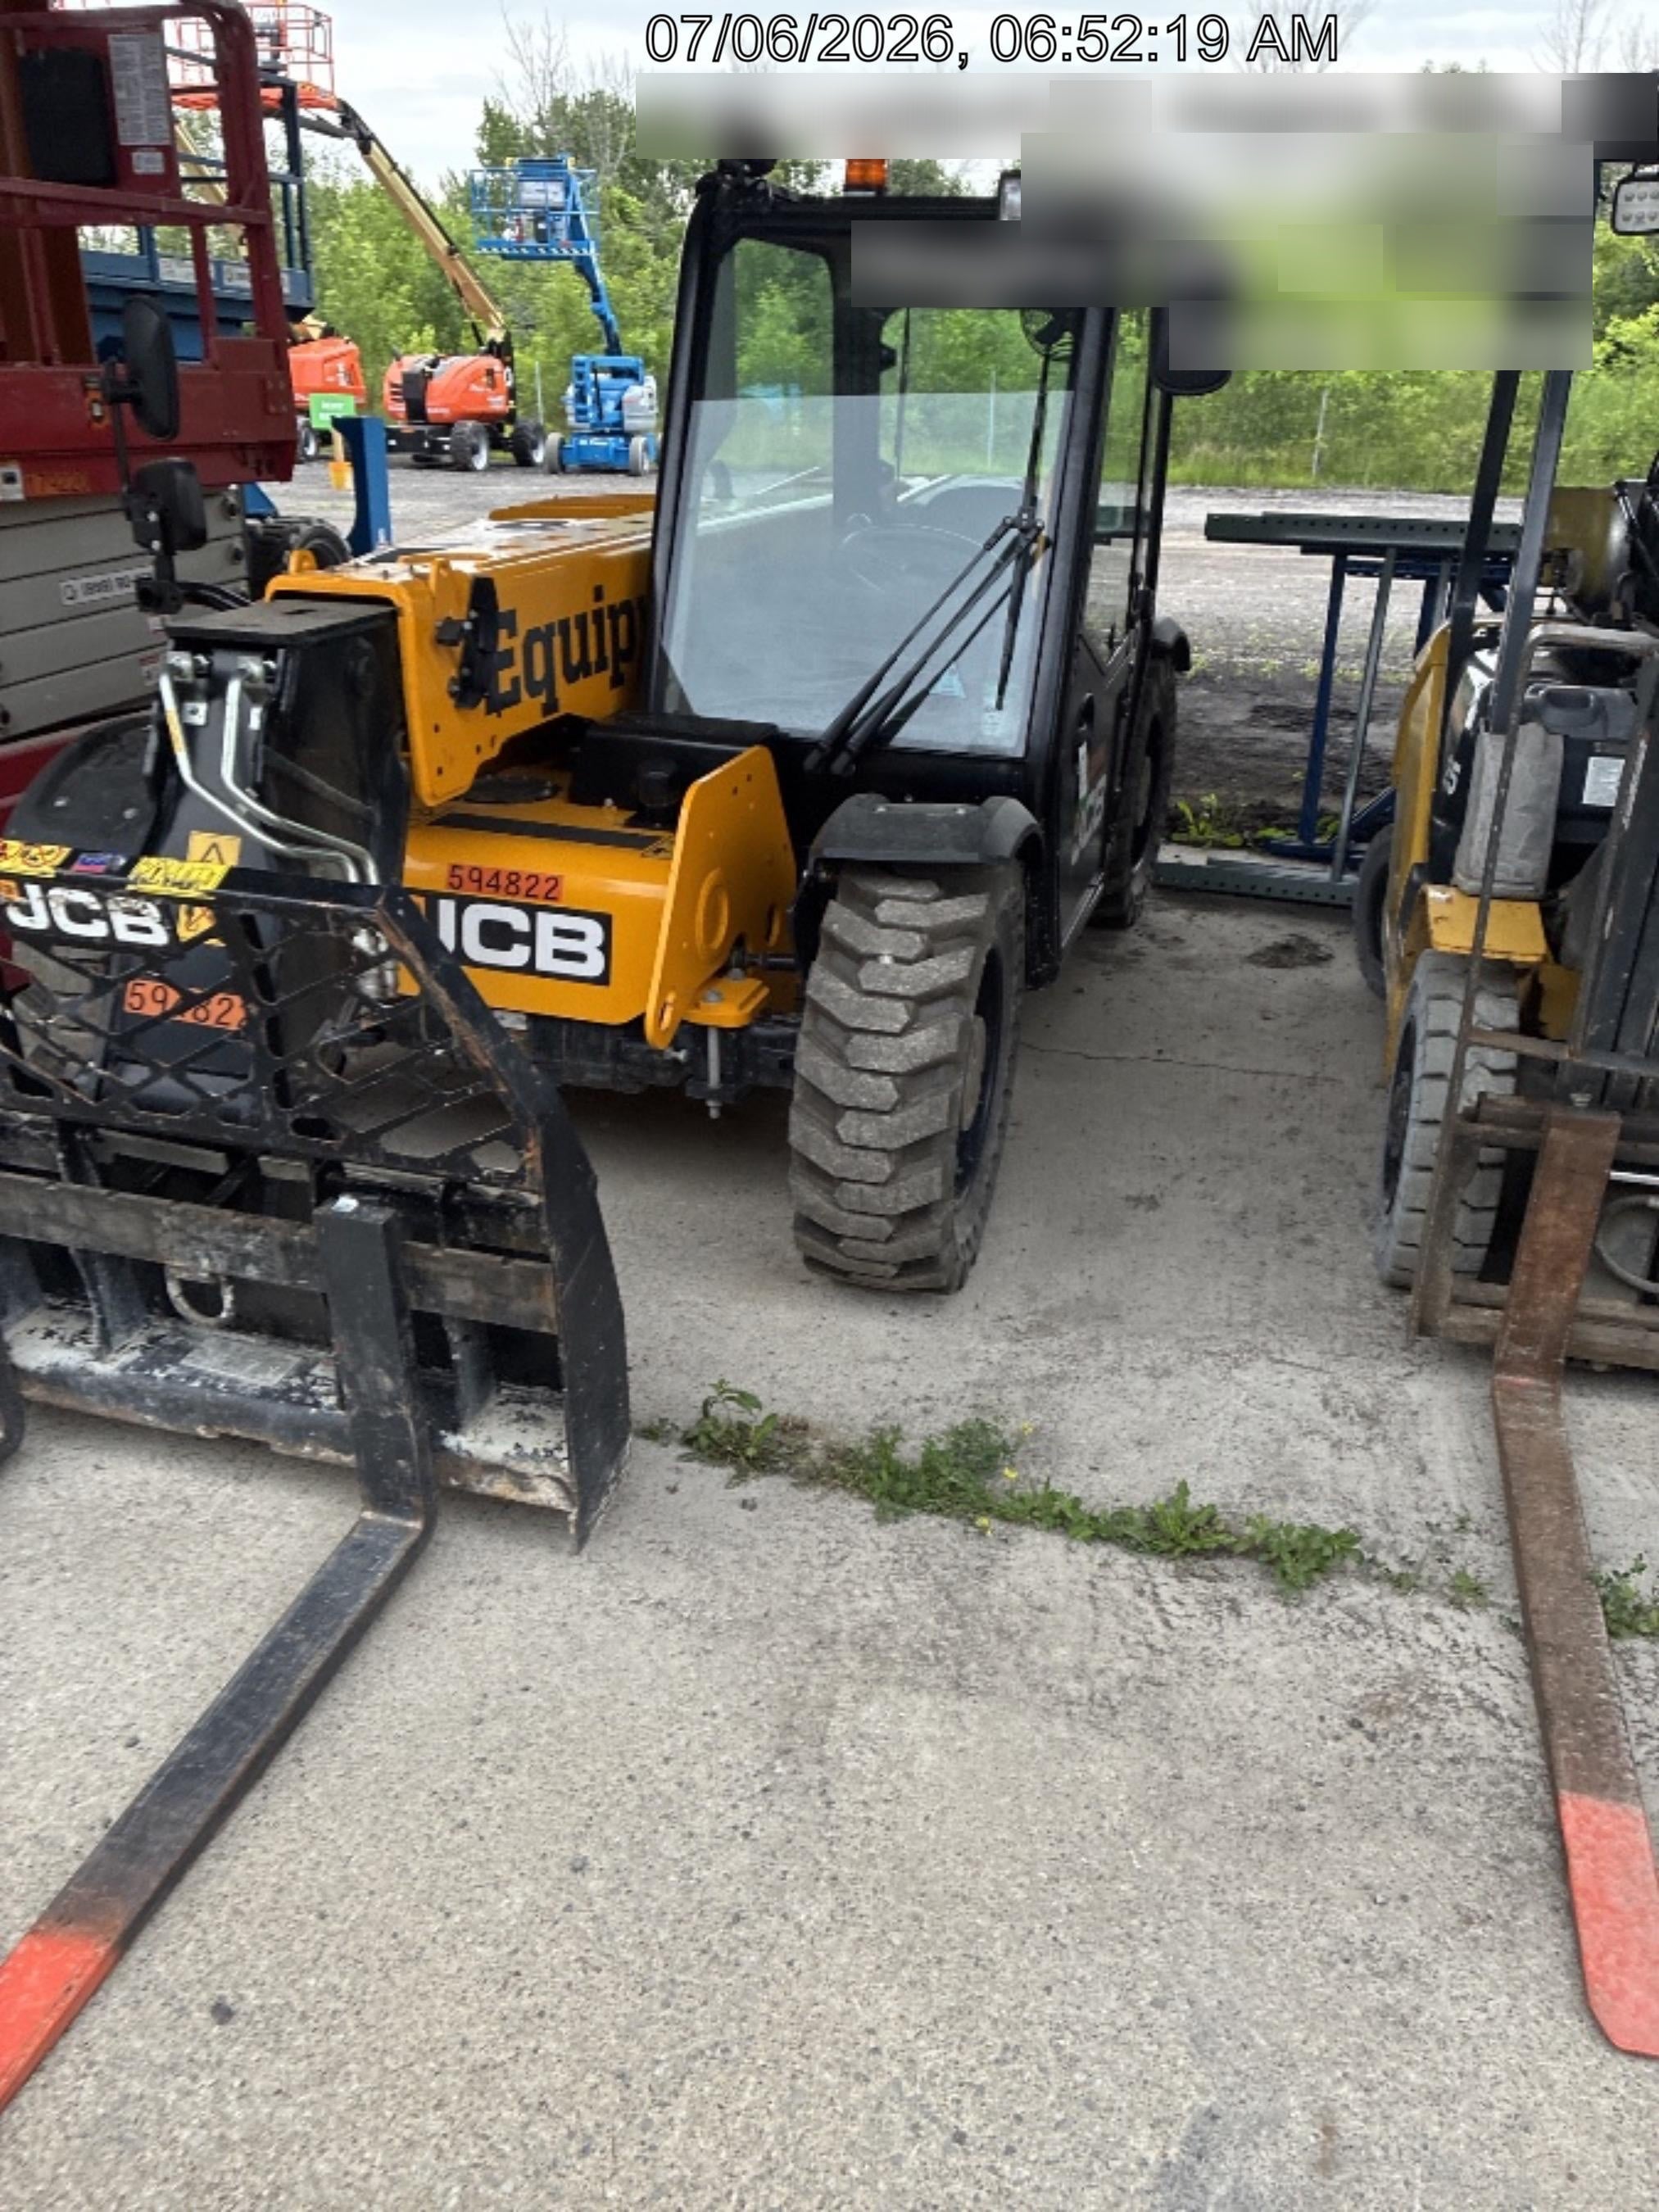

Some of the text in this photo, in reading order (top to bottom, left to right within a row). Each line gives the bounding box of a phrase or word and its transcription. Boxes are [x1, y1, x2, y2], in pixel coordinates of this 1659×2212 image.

[485, 584, 645, 718] Equip
[448, 865, 560, 900] 594822
[6, 884, 170, 946] JCB
[128, 983, 245, 1029] 5982
